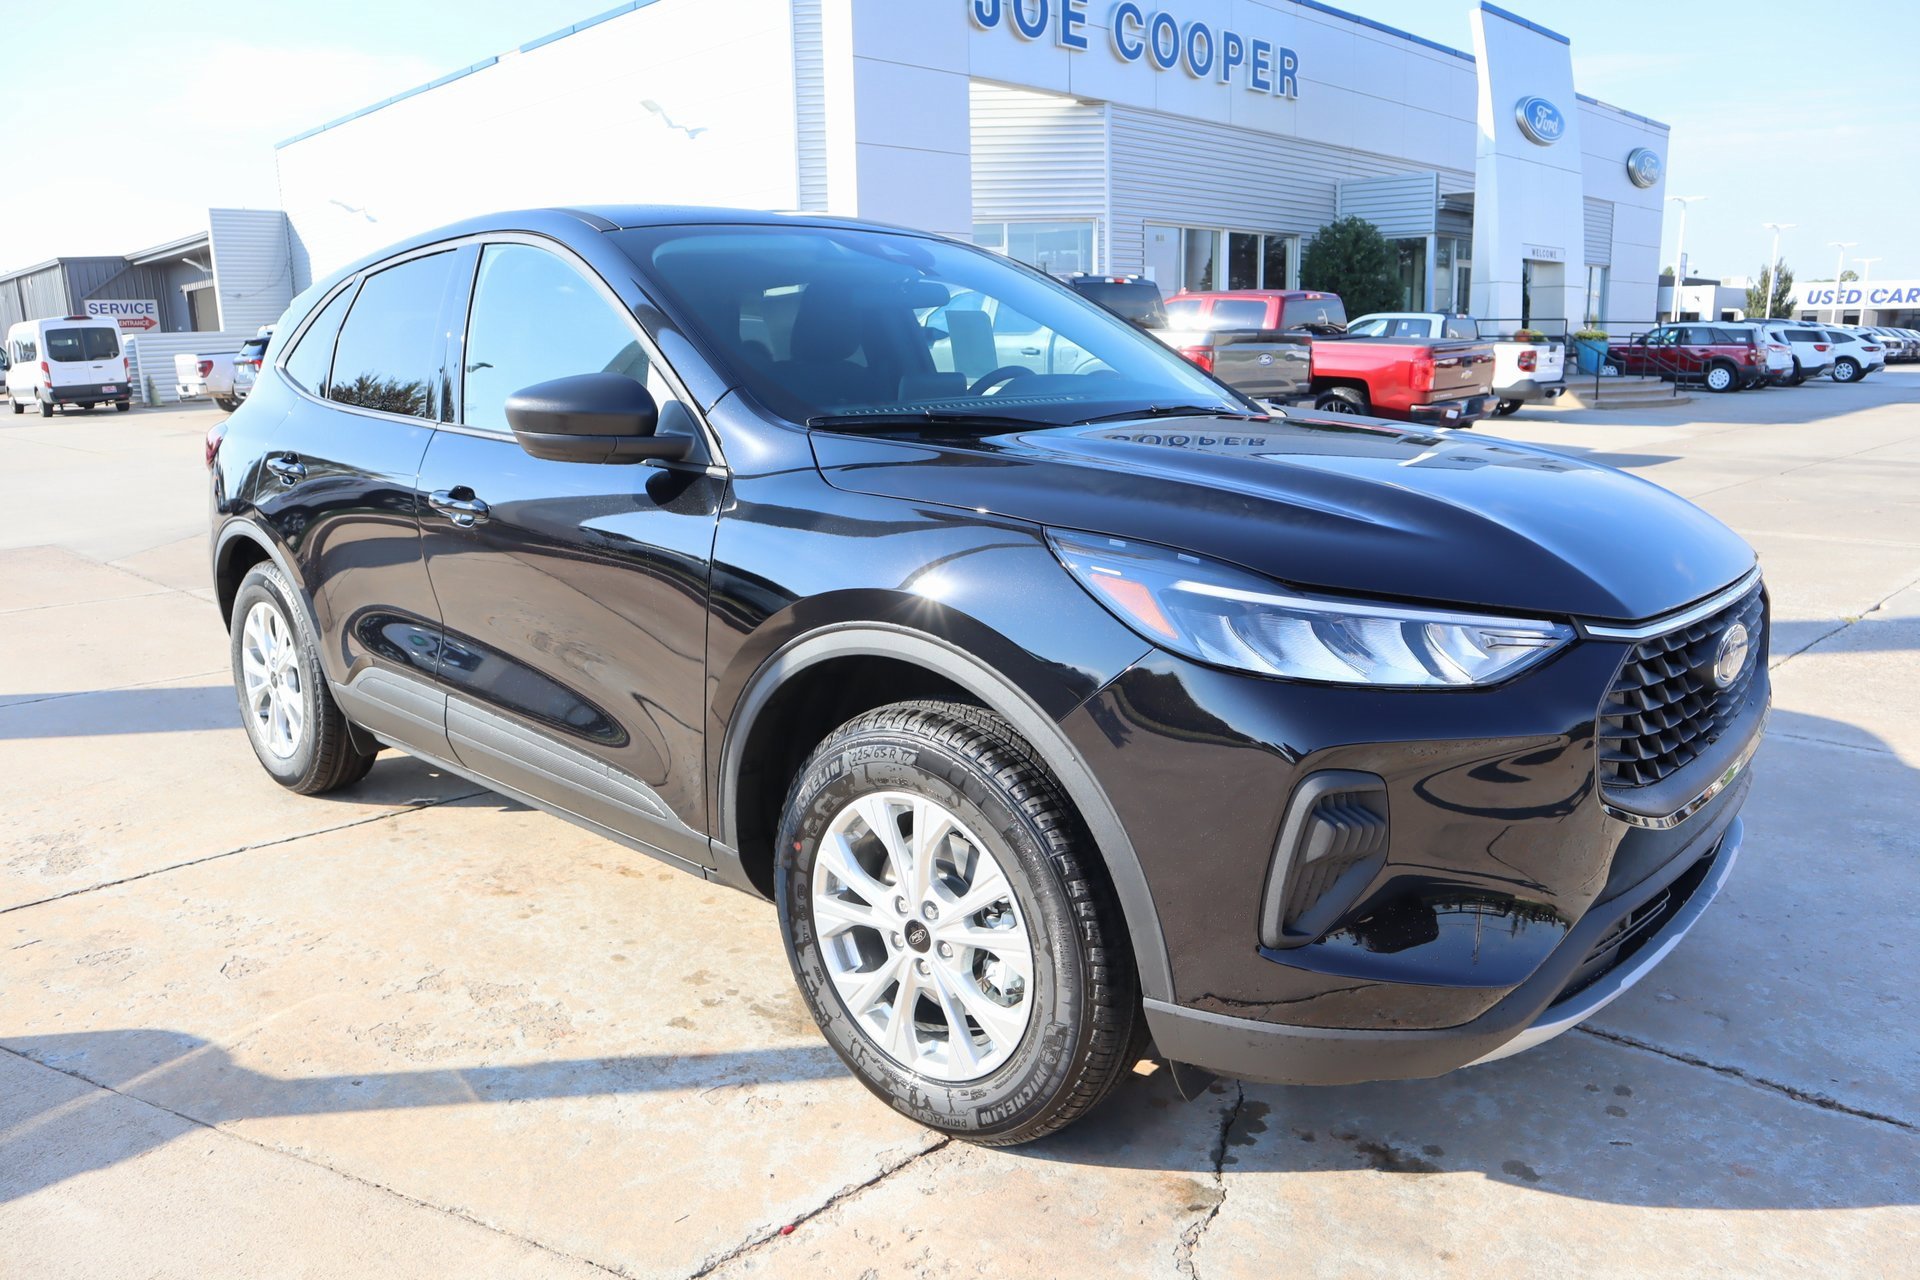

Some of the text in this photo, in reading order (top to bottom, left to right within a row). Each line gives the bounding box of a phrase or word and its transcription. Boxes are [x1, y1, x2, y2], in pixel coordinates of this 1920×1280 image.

[1110, 1, 1300, 98] COOPER
[1535, 105, 1559, 134] Ford
[1531, 248, 1558, 258] WELCOME
[1807, 289, 1862, 304] USED
[88, 303, 154, 314] SERVICE
[784, 760, 840, 833] MICHELIN
[981, 1065, 1048, 1125] MICHELIN
[918, 1111, 967, 1128] PRIMACY
